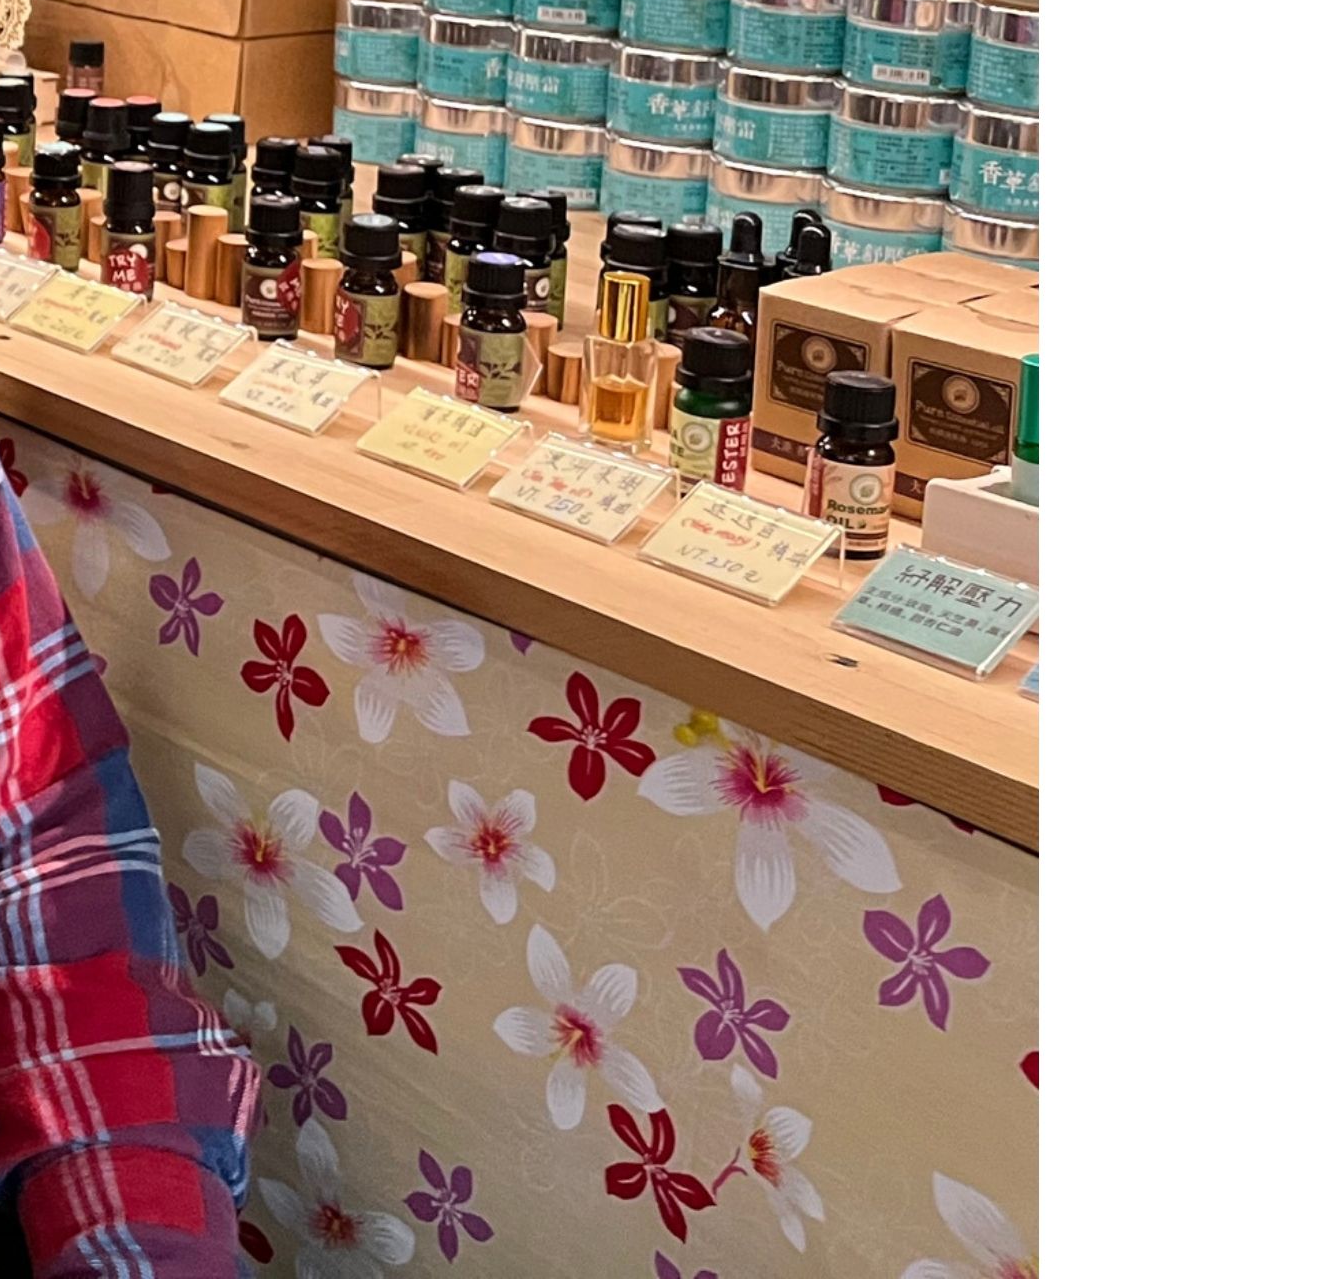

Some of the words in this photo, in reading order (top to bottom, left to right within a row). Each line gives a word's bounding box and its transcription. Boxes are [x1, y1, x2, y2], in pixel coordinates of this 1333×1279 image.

[108, 253, 137, 268] TRY
[112, 269, 137, 282] ME
[721, 423, 741, 486] ESTER
[894, 564, 1023, 618] 紓解壓力
